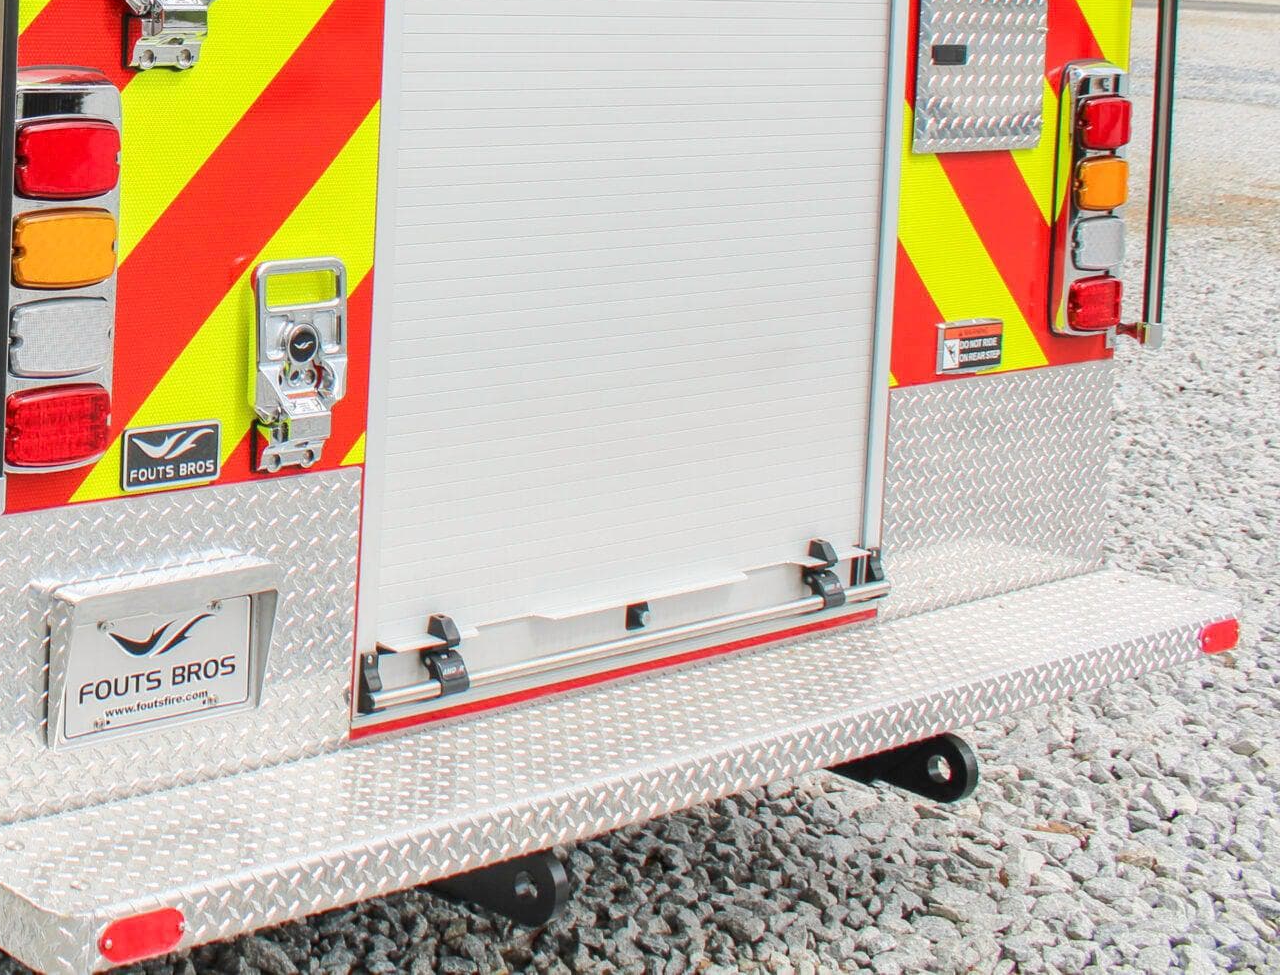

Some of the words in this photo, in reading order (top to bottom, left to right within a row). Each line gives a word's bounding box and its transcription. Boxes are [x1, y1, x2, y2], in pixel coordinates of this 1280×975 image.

[959, 340, 970, 349] DO
[970, 339, 981, 348] NOT
[982, 337, 998, 346] RIDE
[959, 353, 969, 362] ON
[969, 351, 985, 361] REAR
[985, 349, 1001, 359] STEP
[129, 465, 175, 482] FOUTS
[179, 460, 215, 476] BROS
[78, 669, 162, 705] FOUTS
[171, 655, 236, 686] BROS
[104, 689, 209, 718] www.foutsfire.com
